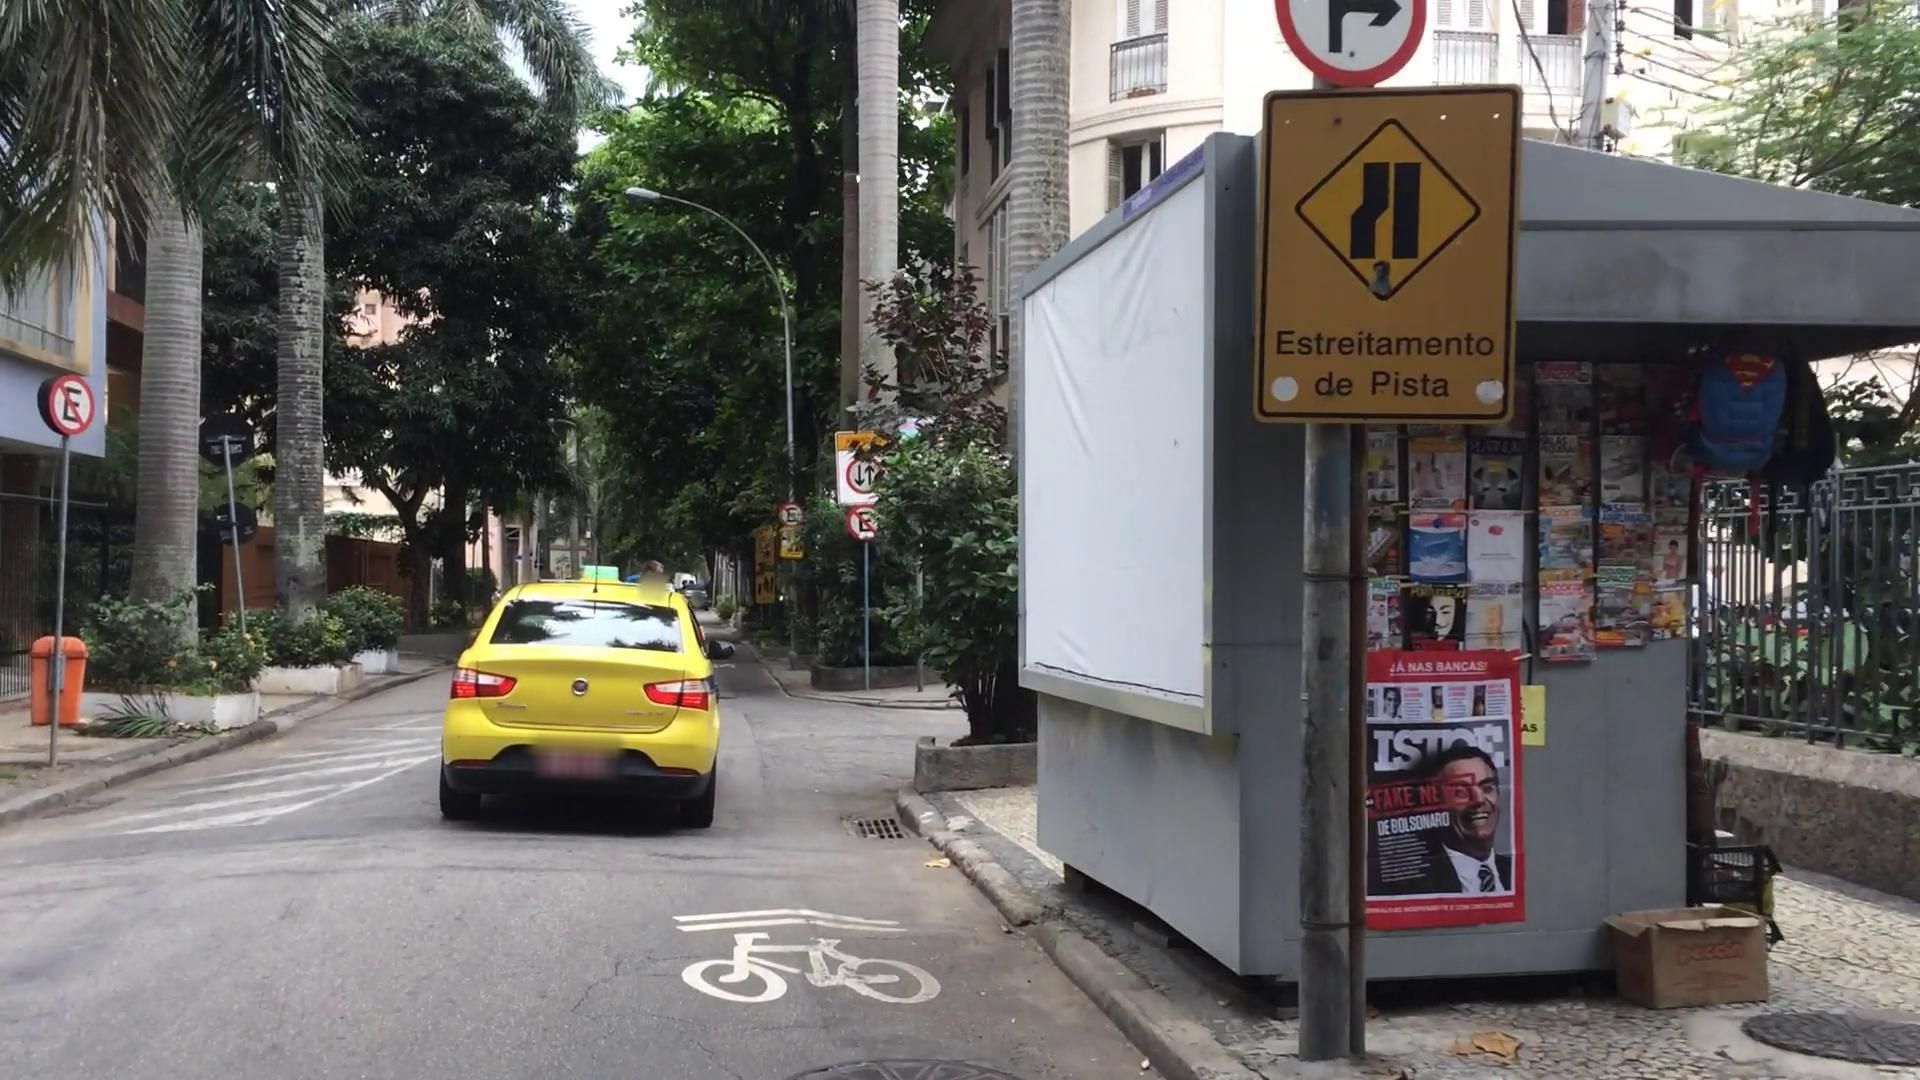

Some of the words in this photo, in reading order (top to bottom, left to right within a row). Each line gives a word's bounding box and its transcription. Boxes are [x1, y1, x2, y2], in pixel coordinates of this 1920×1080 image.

[1276, 330, 1495, 356] Estreitamento
[1314, 371, 1353, 396] de
[1371, 371, 1449, 397] Pista
[62, 387, 82, 423] E
[1390, 660, 1406, 673] JÁ
[1408, 662, 1433, 672] NAS
[1436, 661, 1488, 672] BANCAS!
[1374, 786, 1412, 809] FAKE
[1377, 819, 1391, 836] DE
[1391, 811, 1450, 834] BOLSONARO
